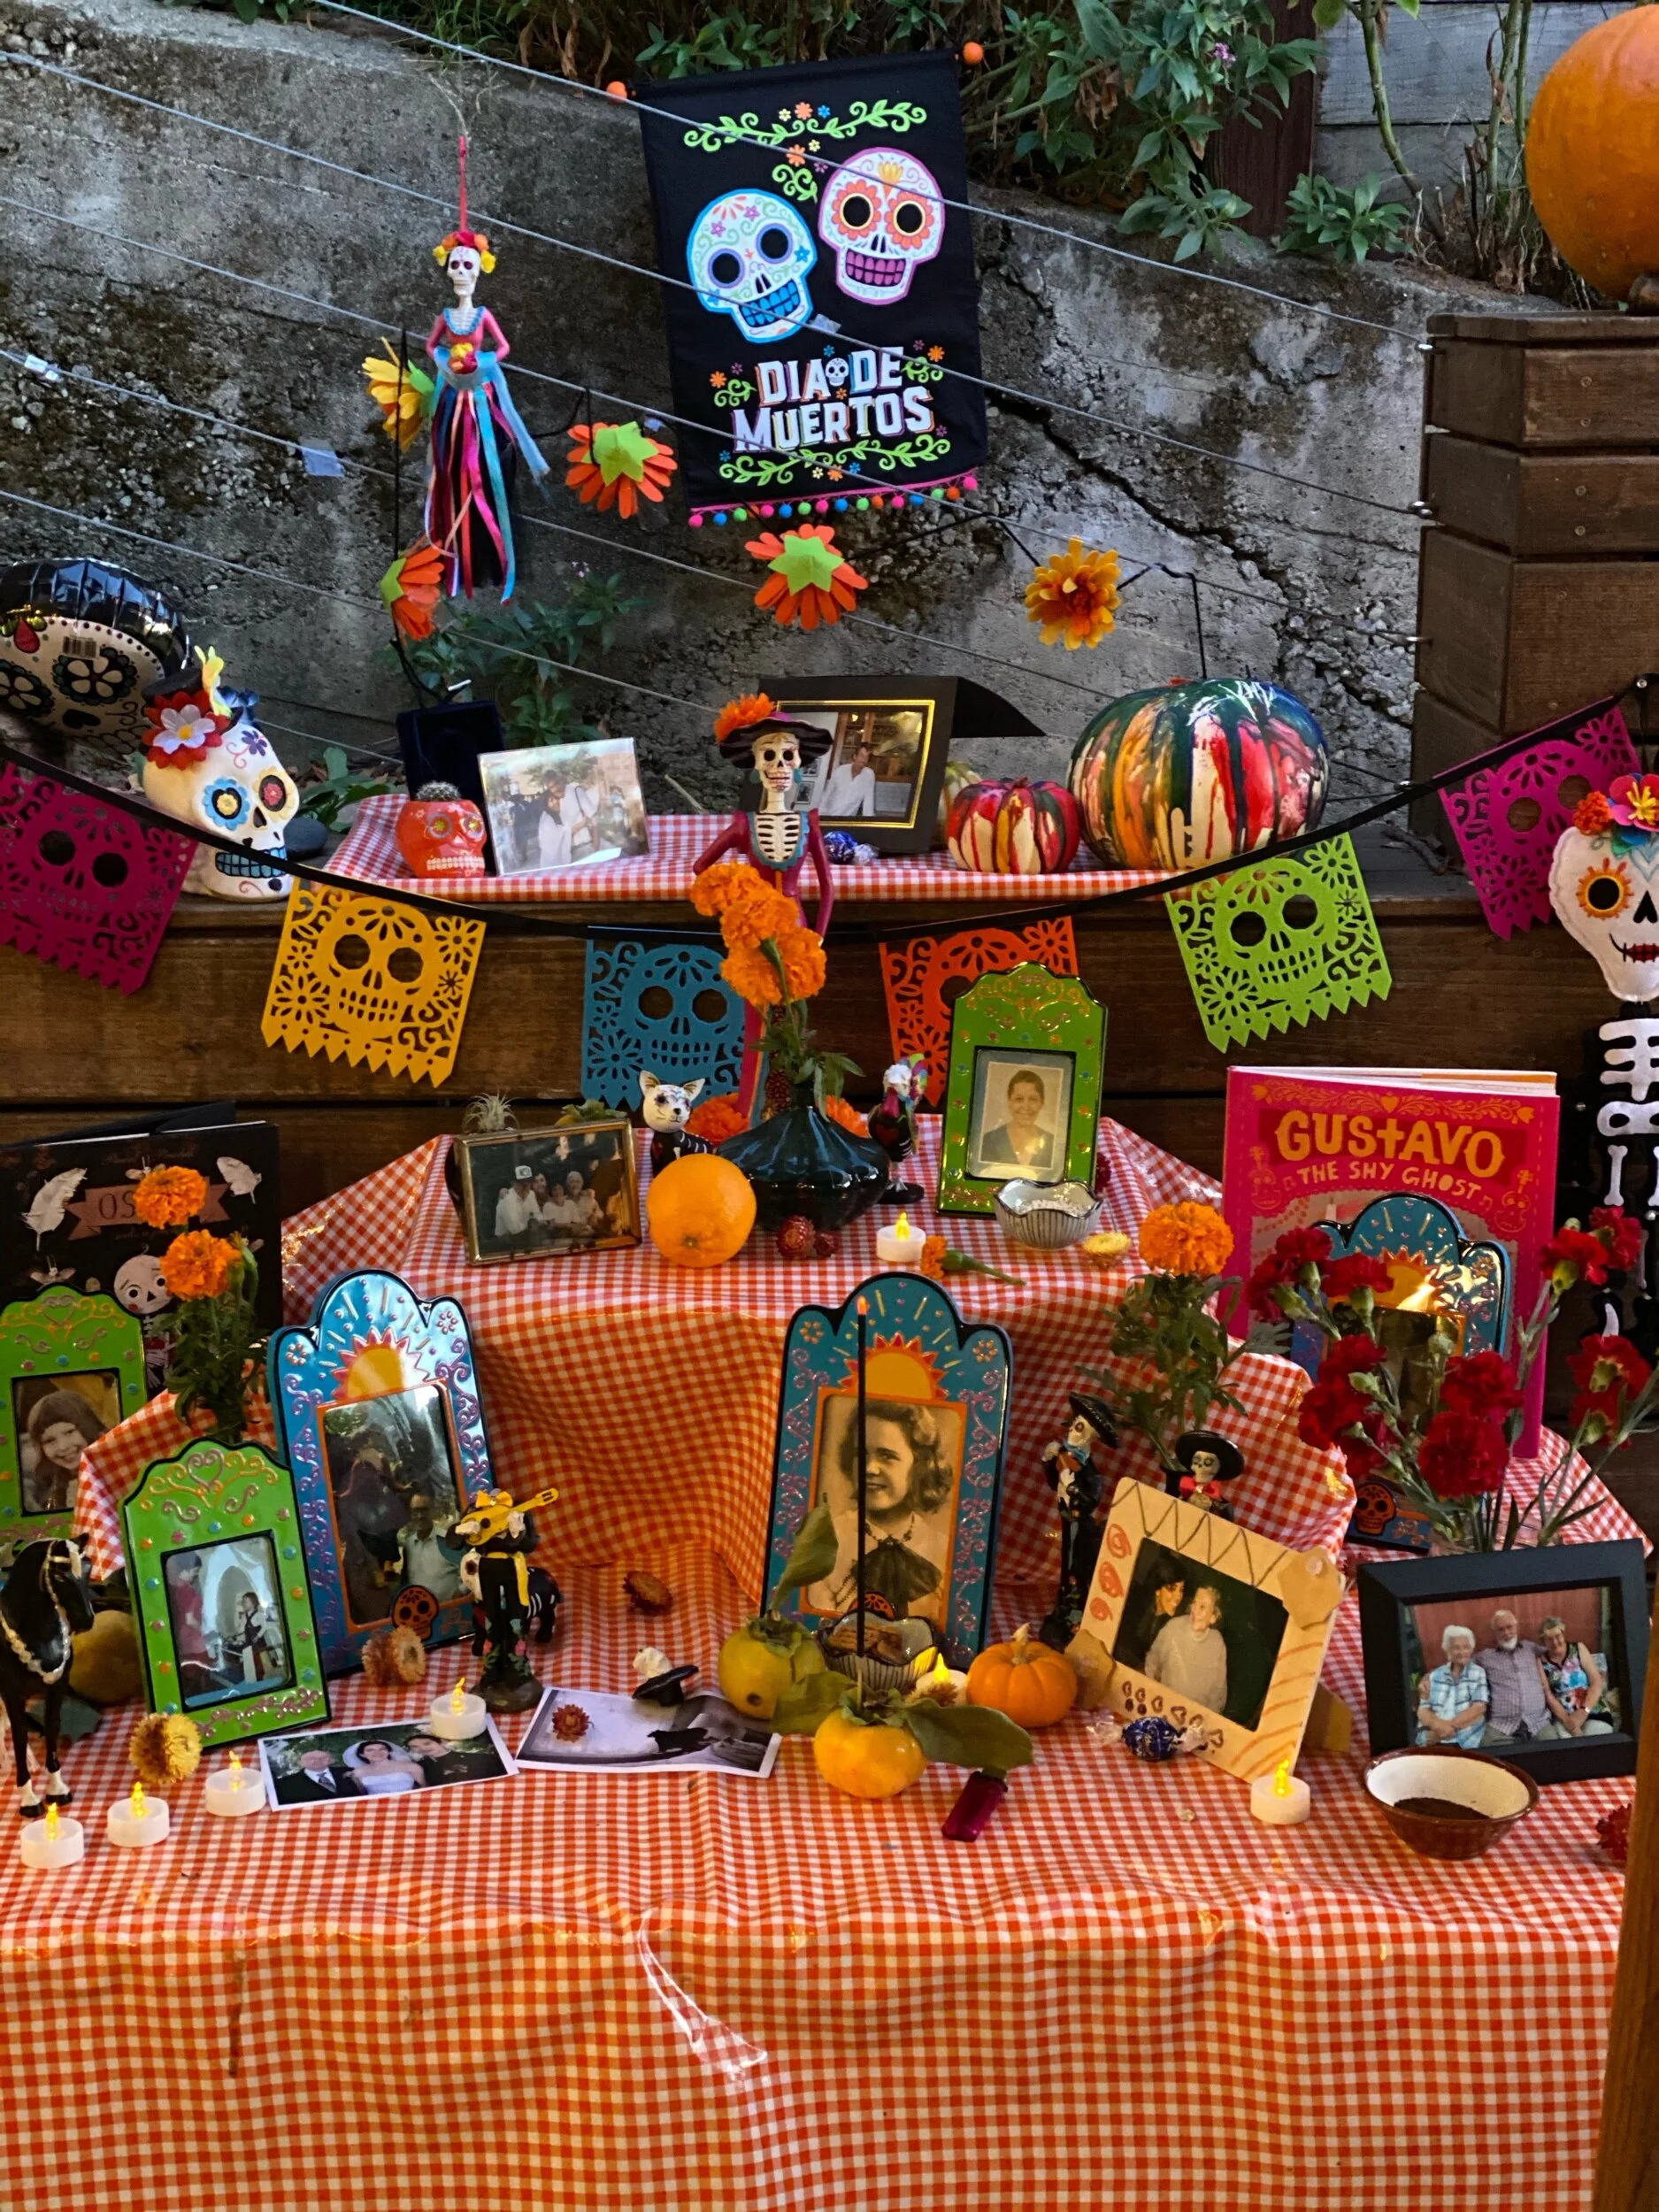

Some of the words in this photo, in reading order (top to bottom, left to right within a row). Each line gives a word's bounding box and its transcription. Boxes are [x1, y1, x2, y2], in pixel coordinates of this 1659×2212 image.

[755, 358, 832, 407] DIA
[848, 346, 904, 395] DE
[730, 385, 934, 454] MUERTOS
[1297, 1161, 1339, 1185] THE
[1348, 1161, 1395, 1181] SHY
[1401, 1166, 1482, 1198] GHOST
